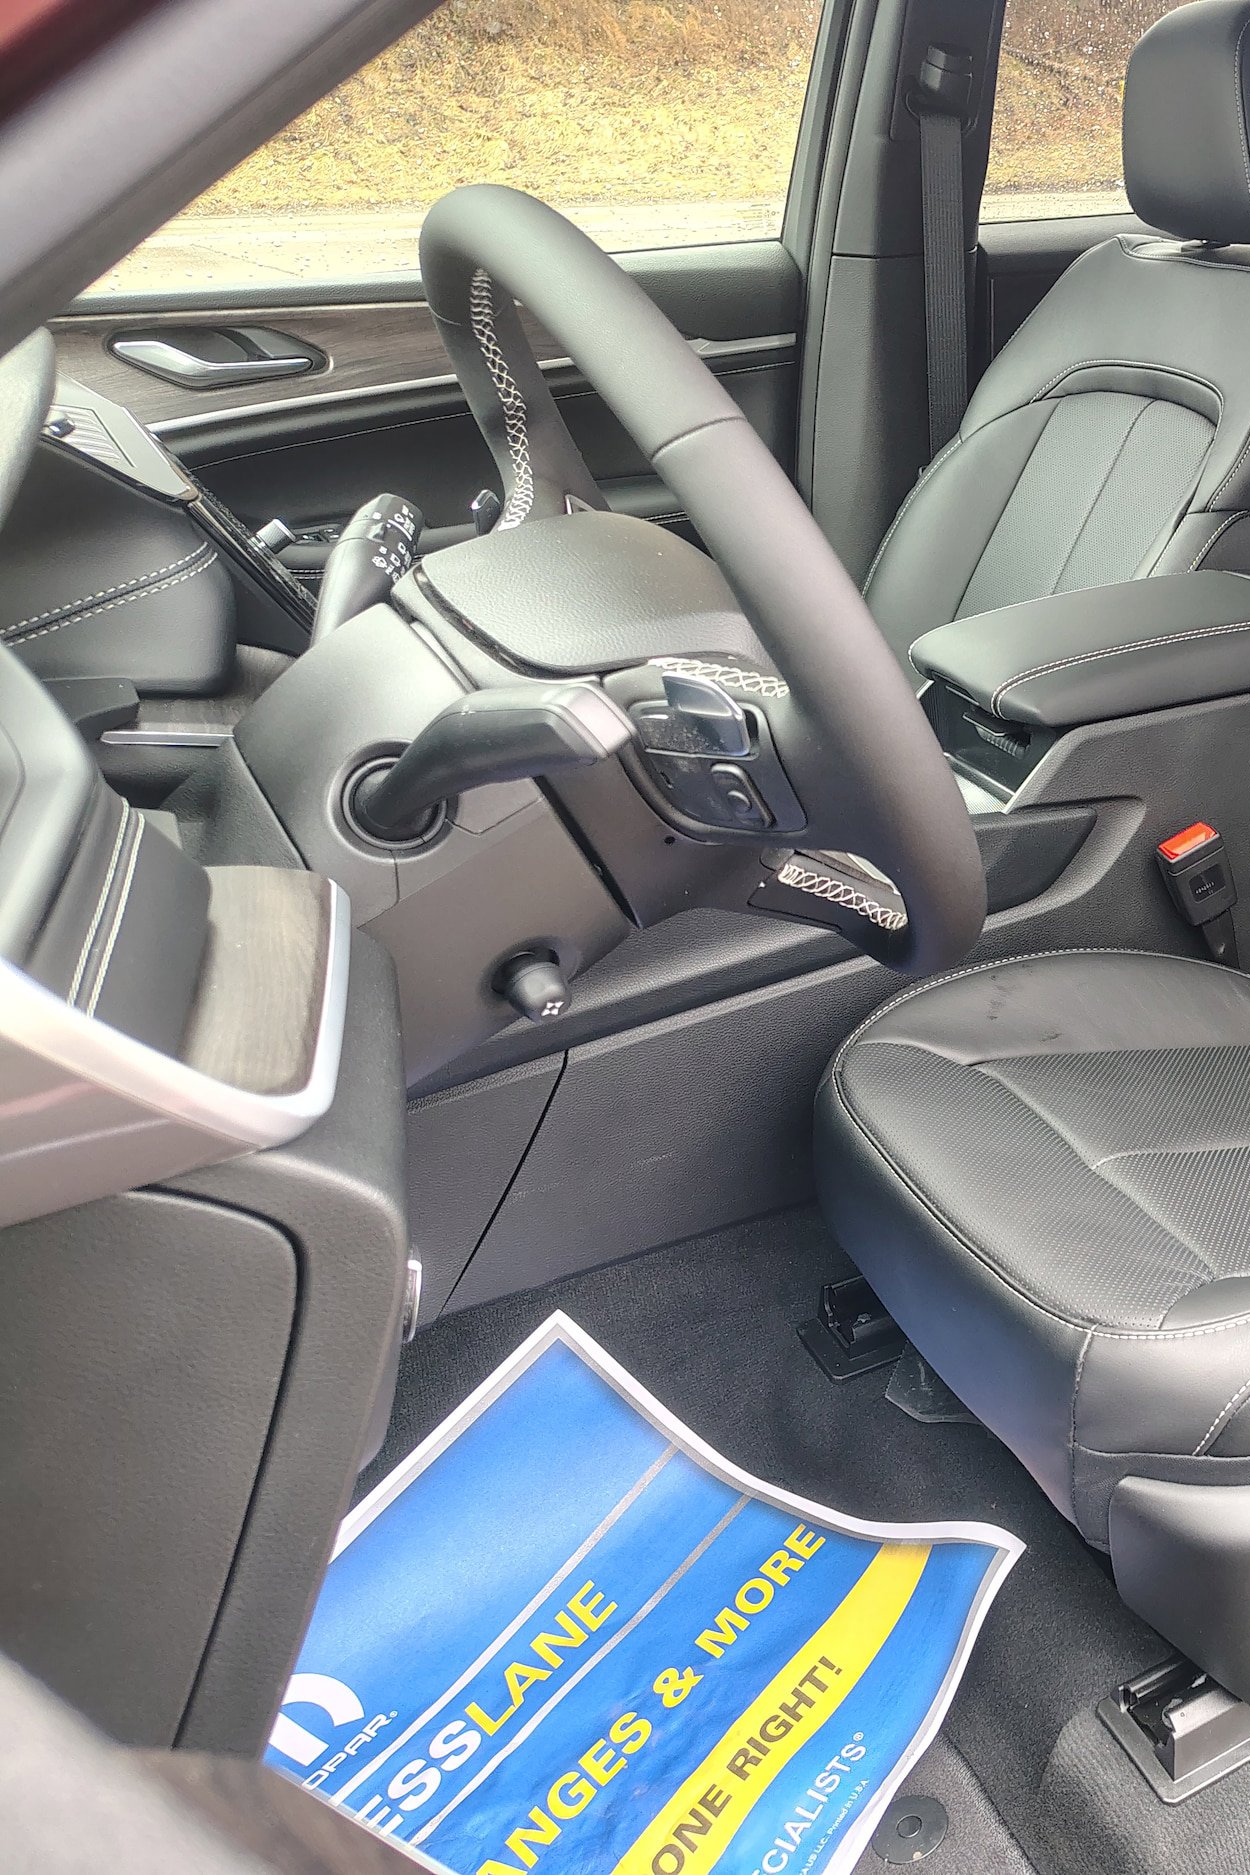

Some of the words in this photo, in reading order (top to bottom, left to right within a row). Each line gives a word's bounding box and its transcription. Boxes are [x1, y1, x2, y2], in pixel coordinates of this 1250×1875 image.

[352, 1580, 618, 1837] ESSLANE
[652, 1666, 704, 1708] &
[694, 1523, 826, 1660] MORE
[651, 1783, 733, 1875] ONE
[726, 1655, 843, 1781] RIGHT!
